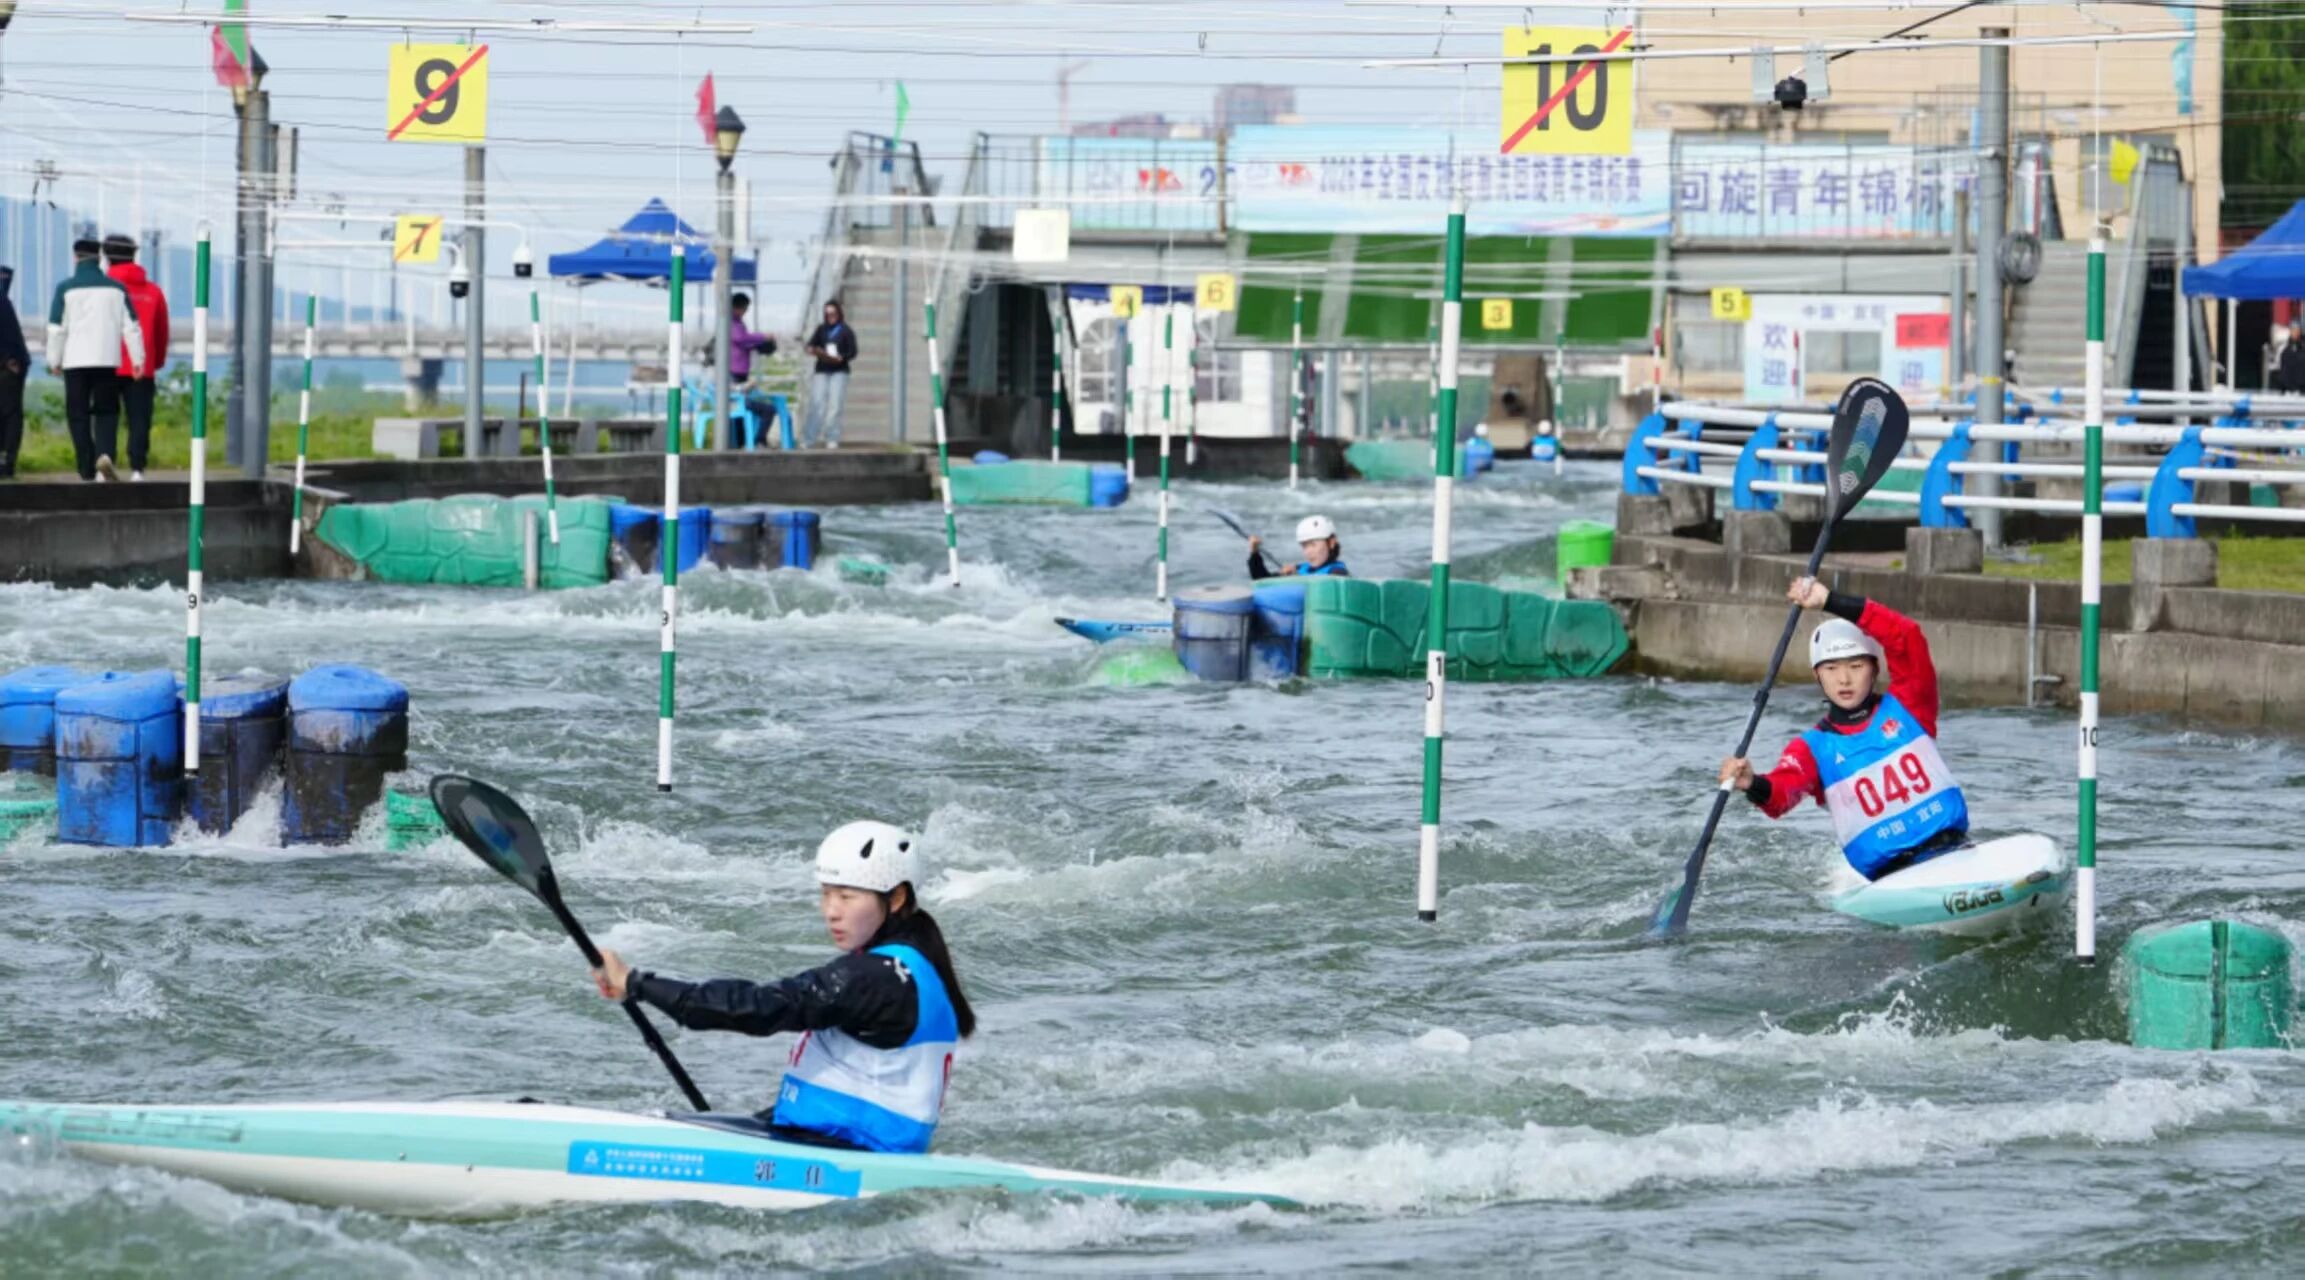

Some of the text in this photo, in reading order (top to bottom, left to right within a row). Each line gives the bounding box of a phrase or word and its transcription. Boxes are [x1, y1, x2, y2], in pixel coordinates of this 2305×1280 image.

[413, 59, 460, 124] 9
[1528, 43, 1609, 132] 10
[410, 225, 431, 255] 7
[1208, 280, 1225, 304] 6
[1720, 292, 1735, 313] 5
[1489, 301, 1505, 323] 3
[188, 593, 197, 609] 9
[2081, 726, 2098, 748] 10
[1854, 751, 1932, 818] 049
